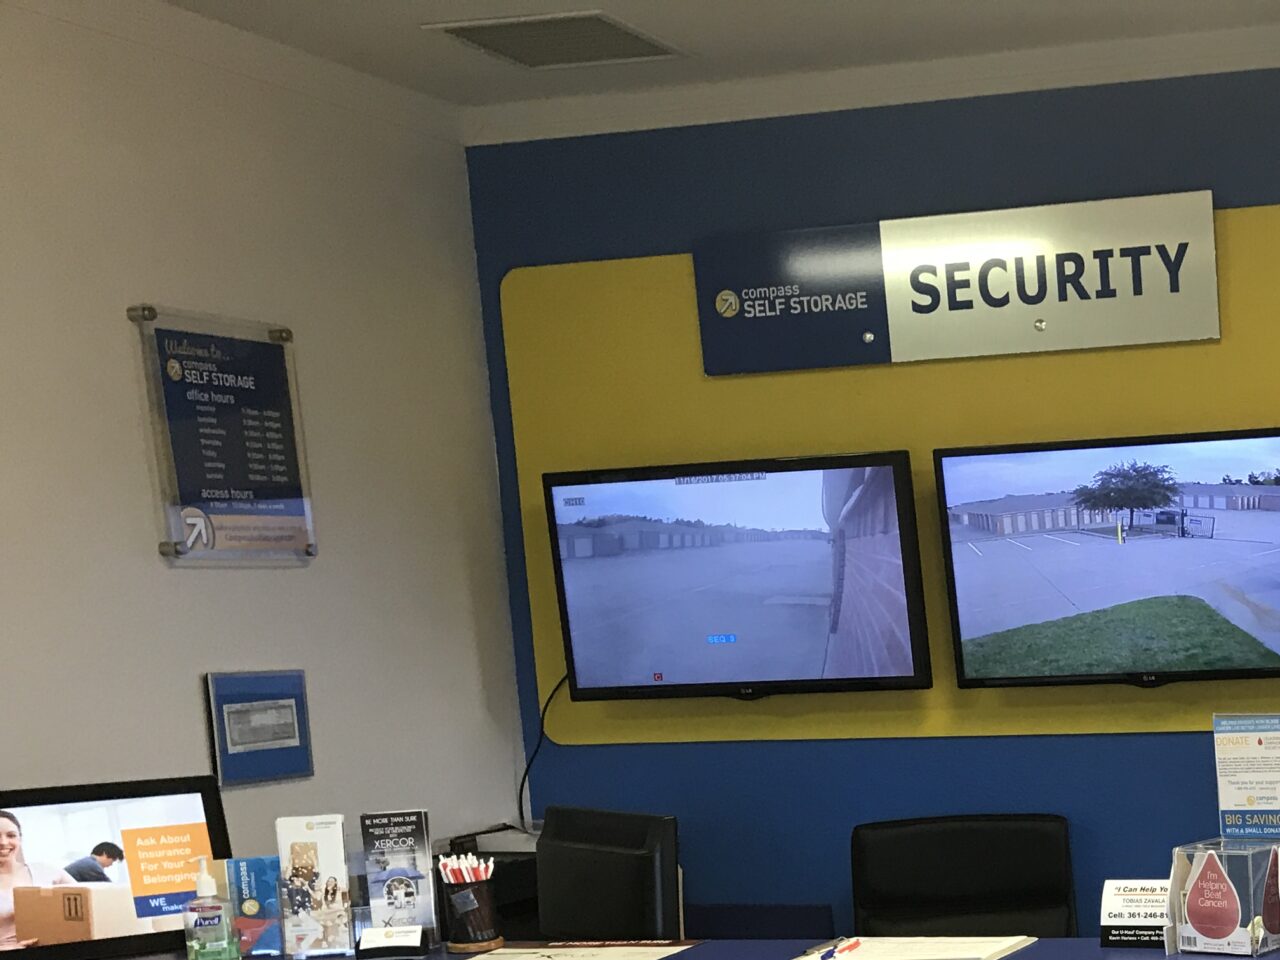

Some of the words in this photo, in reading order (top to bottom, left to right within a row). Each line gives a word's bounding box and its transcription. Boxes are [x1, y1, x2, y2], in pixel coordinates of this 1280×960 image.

[908, 242, 1190, 315] SECURITY
[741, 283, 800, 300] compass
[744, 300, 786, 319] SELF
[787, 291, 868, 316] STORAGE
[182, 360, 218, 372] compass
[184, 369, 210, 385] SELF
[211, 373, 256, 390] STORAGE
[186, 388, 210, 402] office
[211, 391, 236, 404] hours
[201, 488, 230, 499] access
[230, 487, 255, 500] hours
[1215, 735, 1250, 747] DONATE
[1224, 814, 1243, 825] BIG
[136, 837, 158, 847] Ask
[159, 833, 192, 845] About
[374, 837, 416, 850] XERCOR
[138, 847, 192, 859] Insurance
[140, 861, 159, 872] For
[161, 859, 186, 870] Your
[239, 861, 250, 899] compass
[1207, 871, 1218, 880] I'm
[1139, 886, 1157, 894] Help
[1198, 880, 1227, 892] Helping
[1204, 890, 1222, 899] Beat
[149, 897, 167, 907] WE
[1198, 898, 1227, 908] Cancer!
[1108, 911, 1125, 919] Cell:
[1127, 911, 1169, 919] 361-246-81
